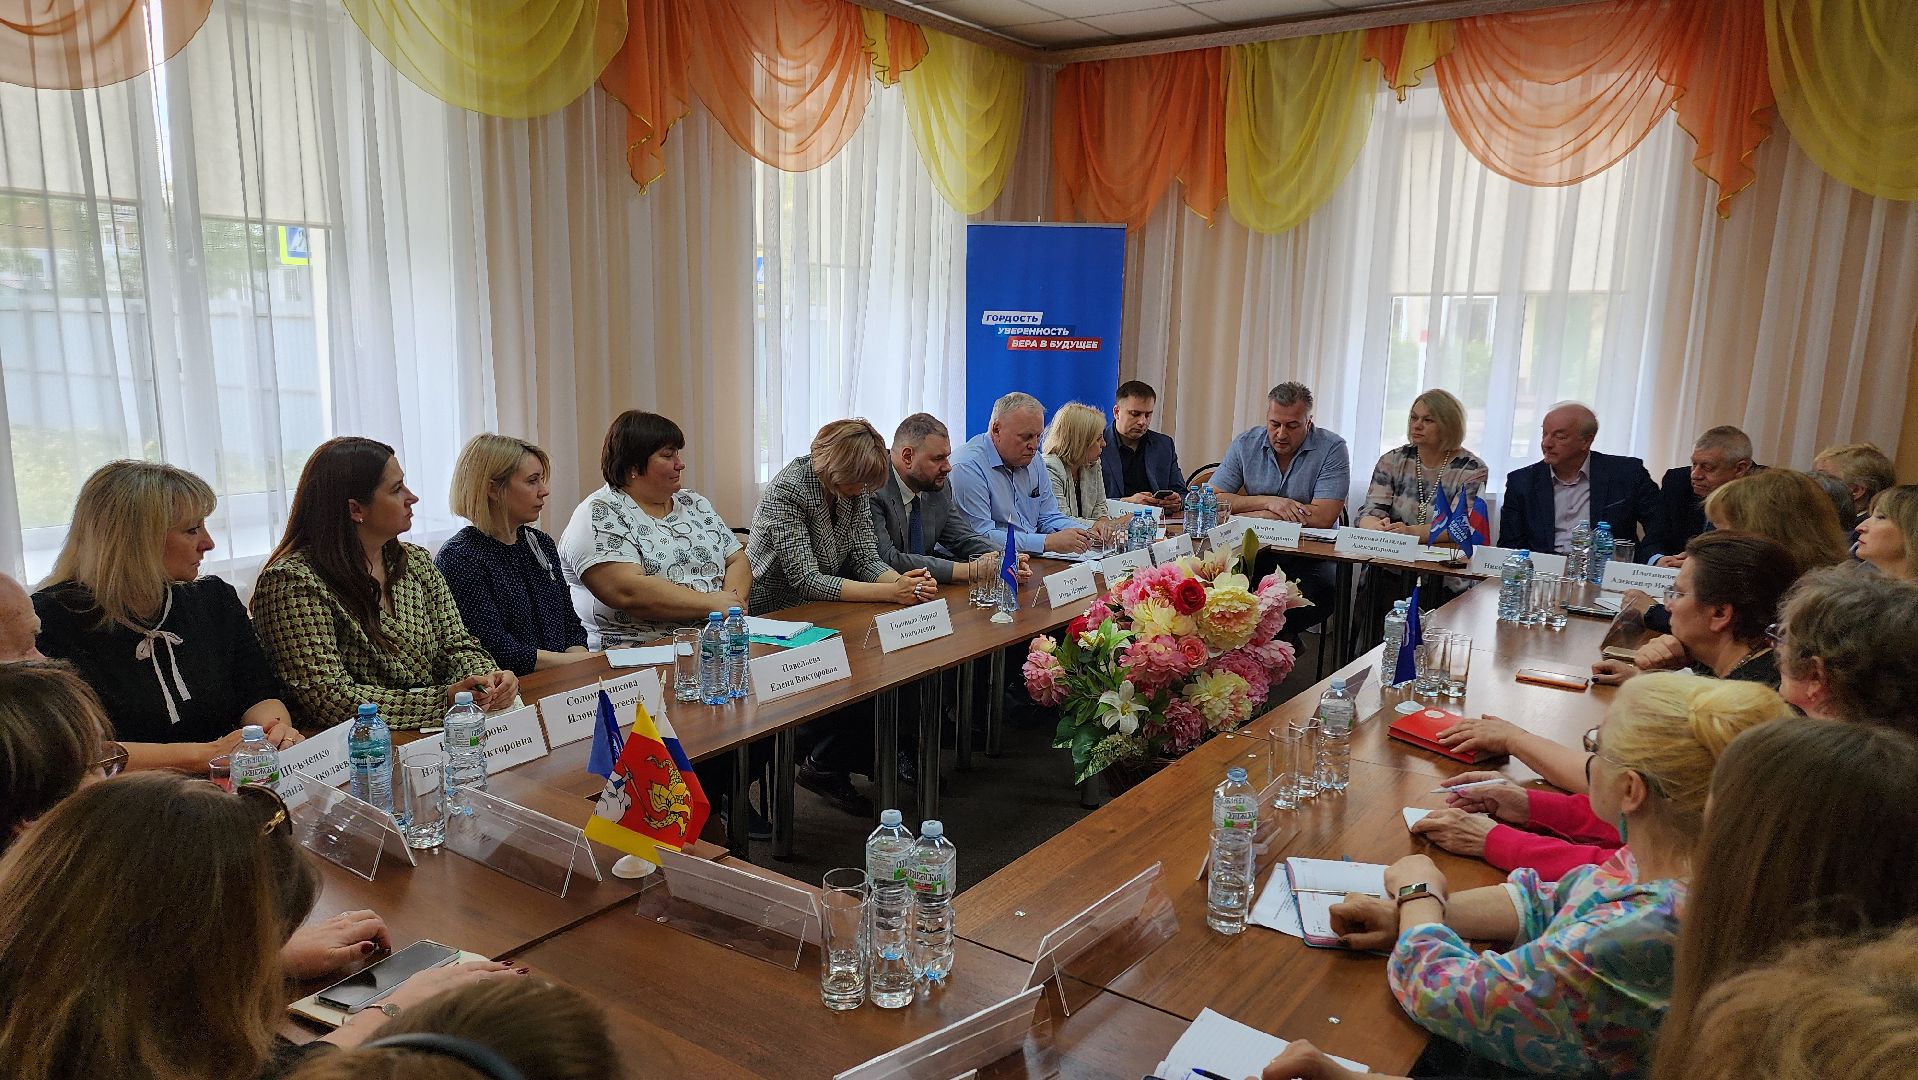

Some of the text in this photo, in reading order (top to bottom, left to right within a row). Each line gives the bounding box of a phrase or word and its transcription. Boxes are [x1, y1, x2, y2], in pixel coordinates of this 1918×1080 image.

[985, 314, 1039, 323] ГОРДОСТЬ
[997, 327, 1070, 336] УВЕРЕННОСТЬ
[1011, 339, 1099, 350] ВЕРА В БУДУЩЕЕ
[770, 666, 839, 692] Елена Викторовна
[482, 736, 533, 759] икторовна
